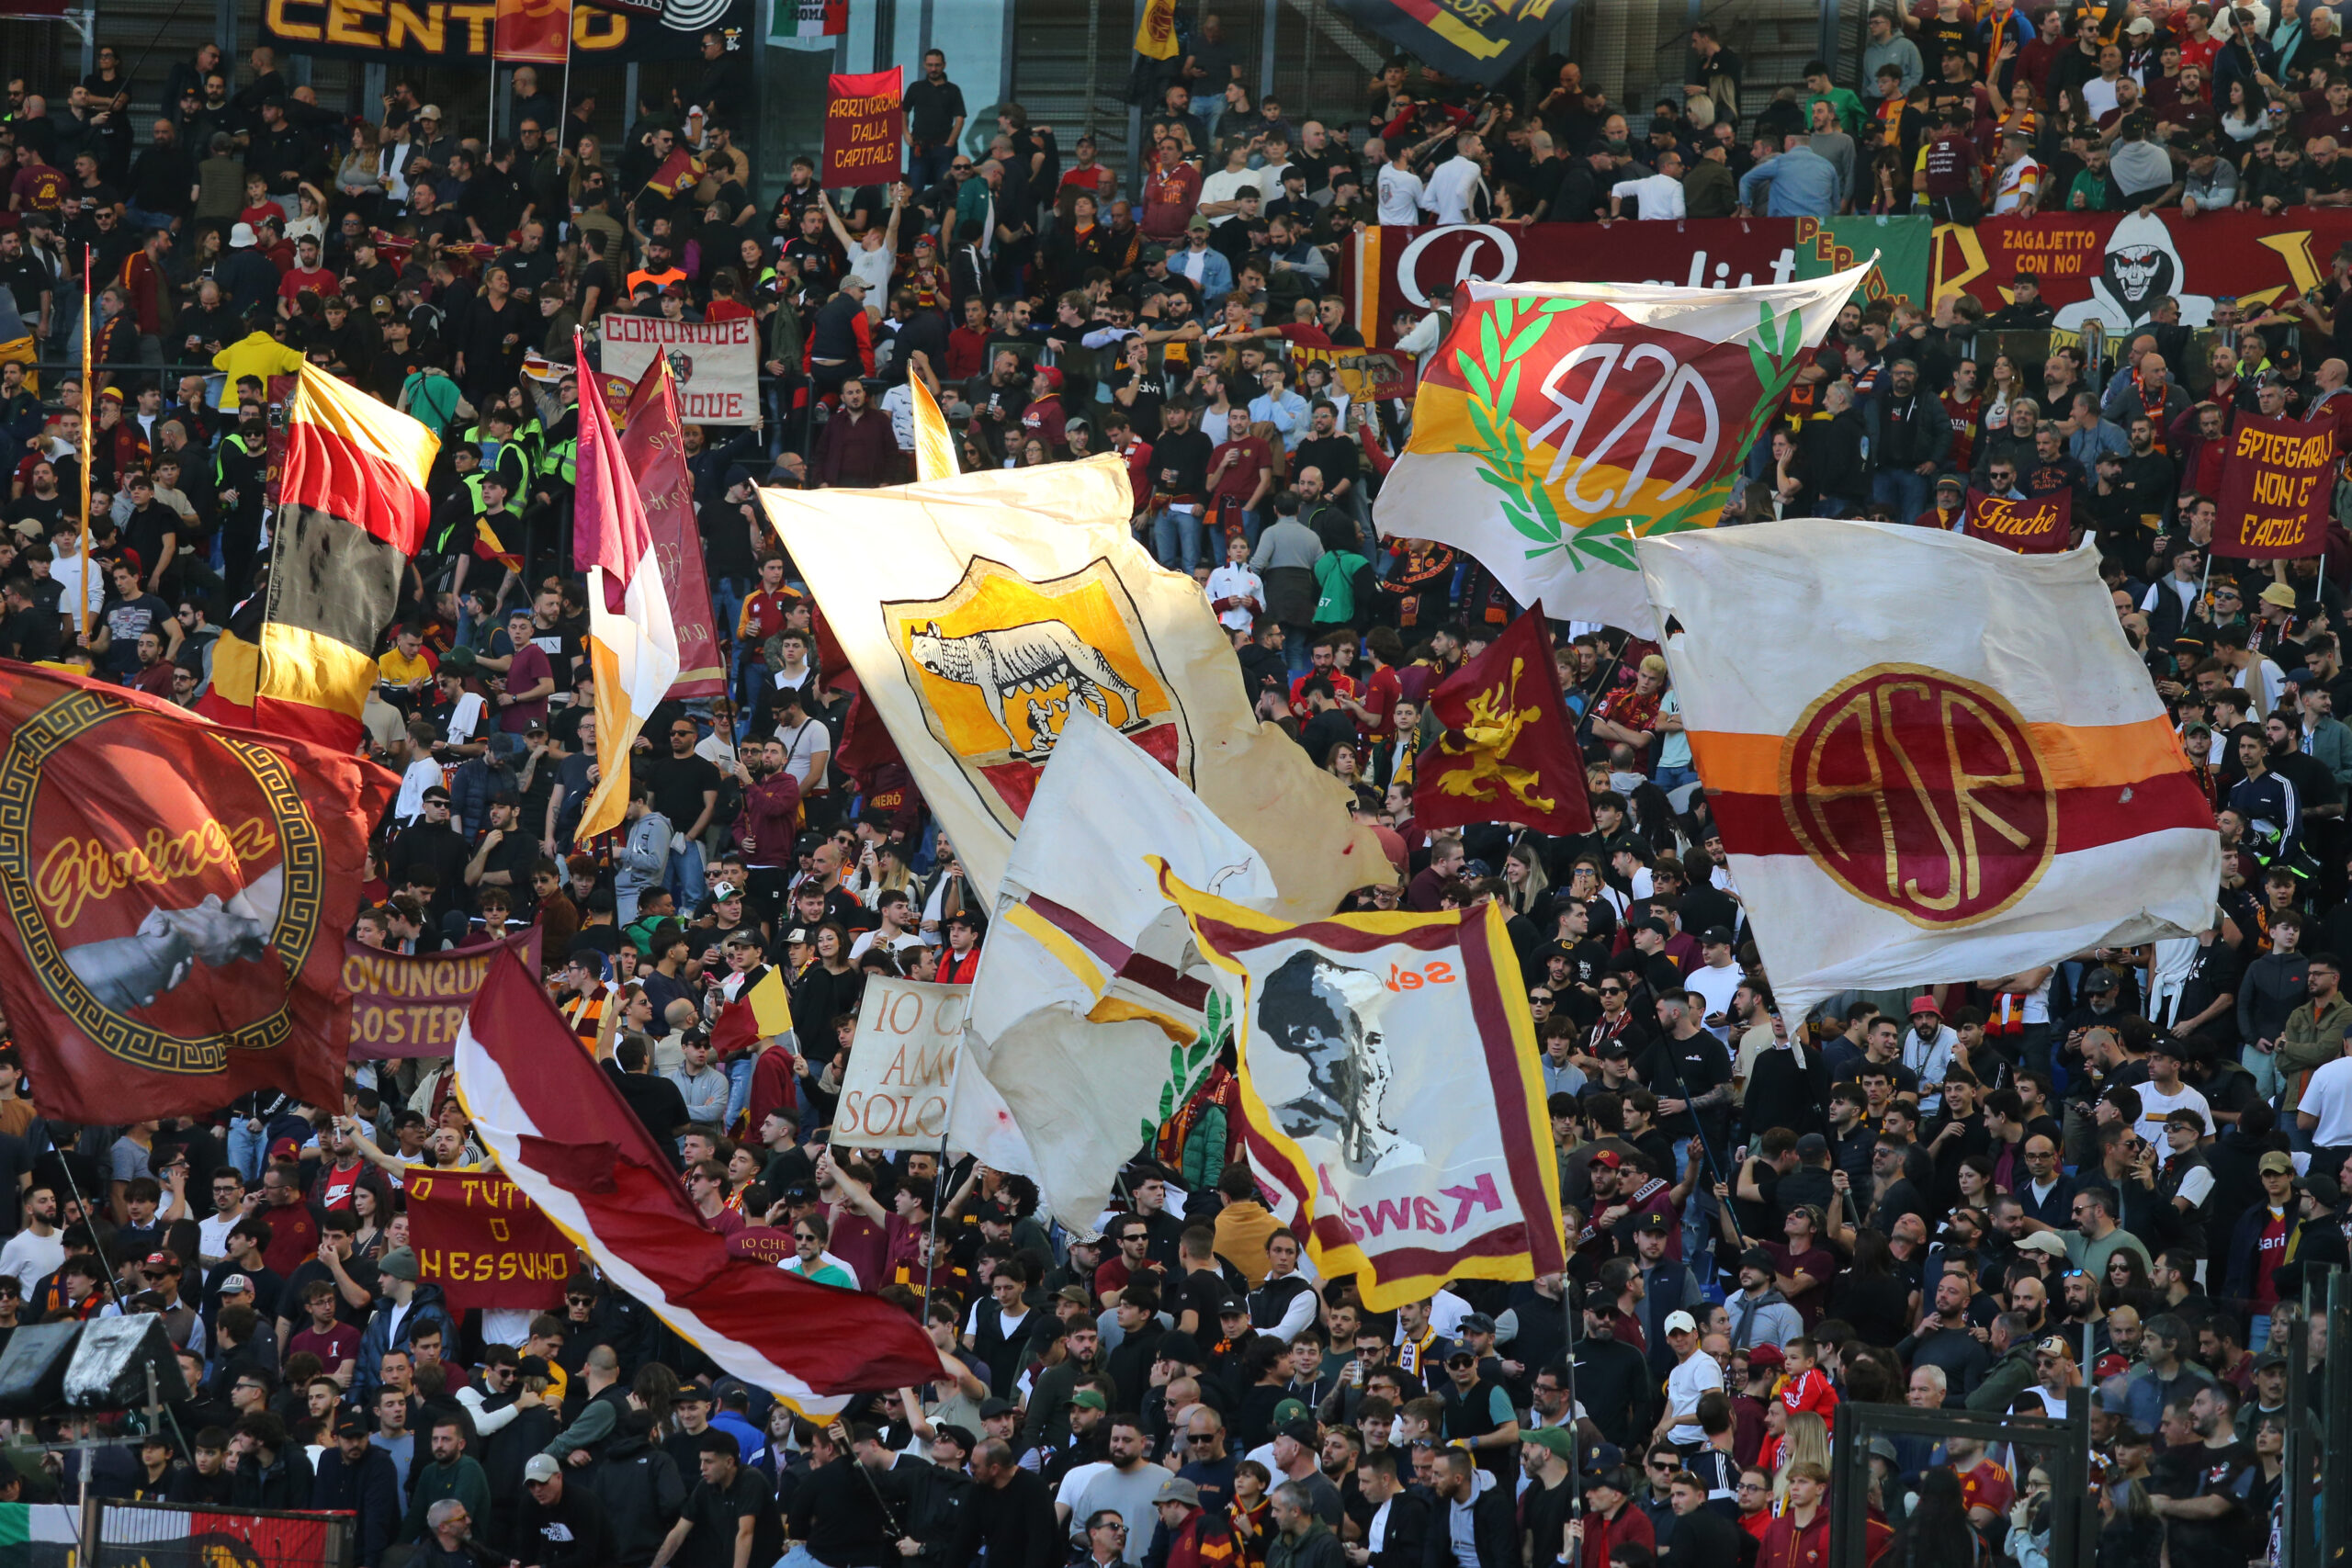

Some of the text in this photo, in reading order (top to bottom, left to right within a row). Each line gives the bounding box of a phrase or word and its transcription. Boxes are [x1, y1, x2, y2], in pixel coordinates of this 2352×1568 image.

[265, 0, 628, 55] CENTO
[788, 8, 829, 21] ROMA
[851, 118, 888, 142] DALLA
[835, 142, 895, 168] CAPITALE
[2003, 230, 2095, 250] ZAGAJETTO
[2016, 254, 2081, 274] CON NOI
[605, 316, 750, 345] COMUNQUE
[2252, 469, 2295, 508] NON
[1973, 498, 2059, 536] Finchè
[2240, 513, 2308, 547] FACILE
[343, 953, 490, 997] OVUNQUE
[349, 1004, 470, 1044] SOSTER
[874, 989, 923, 1035] IO
[839, 1089, 947, 1138] SOLO
[327, 1184, 350, 1198] NIKE
[741, 1238, 787, 1251] IO CHE
